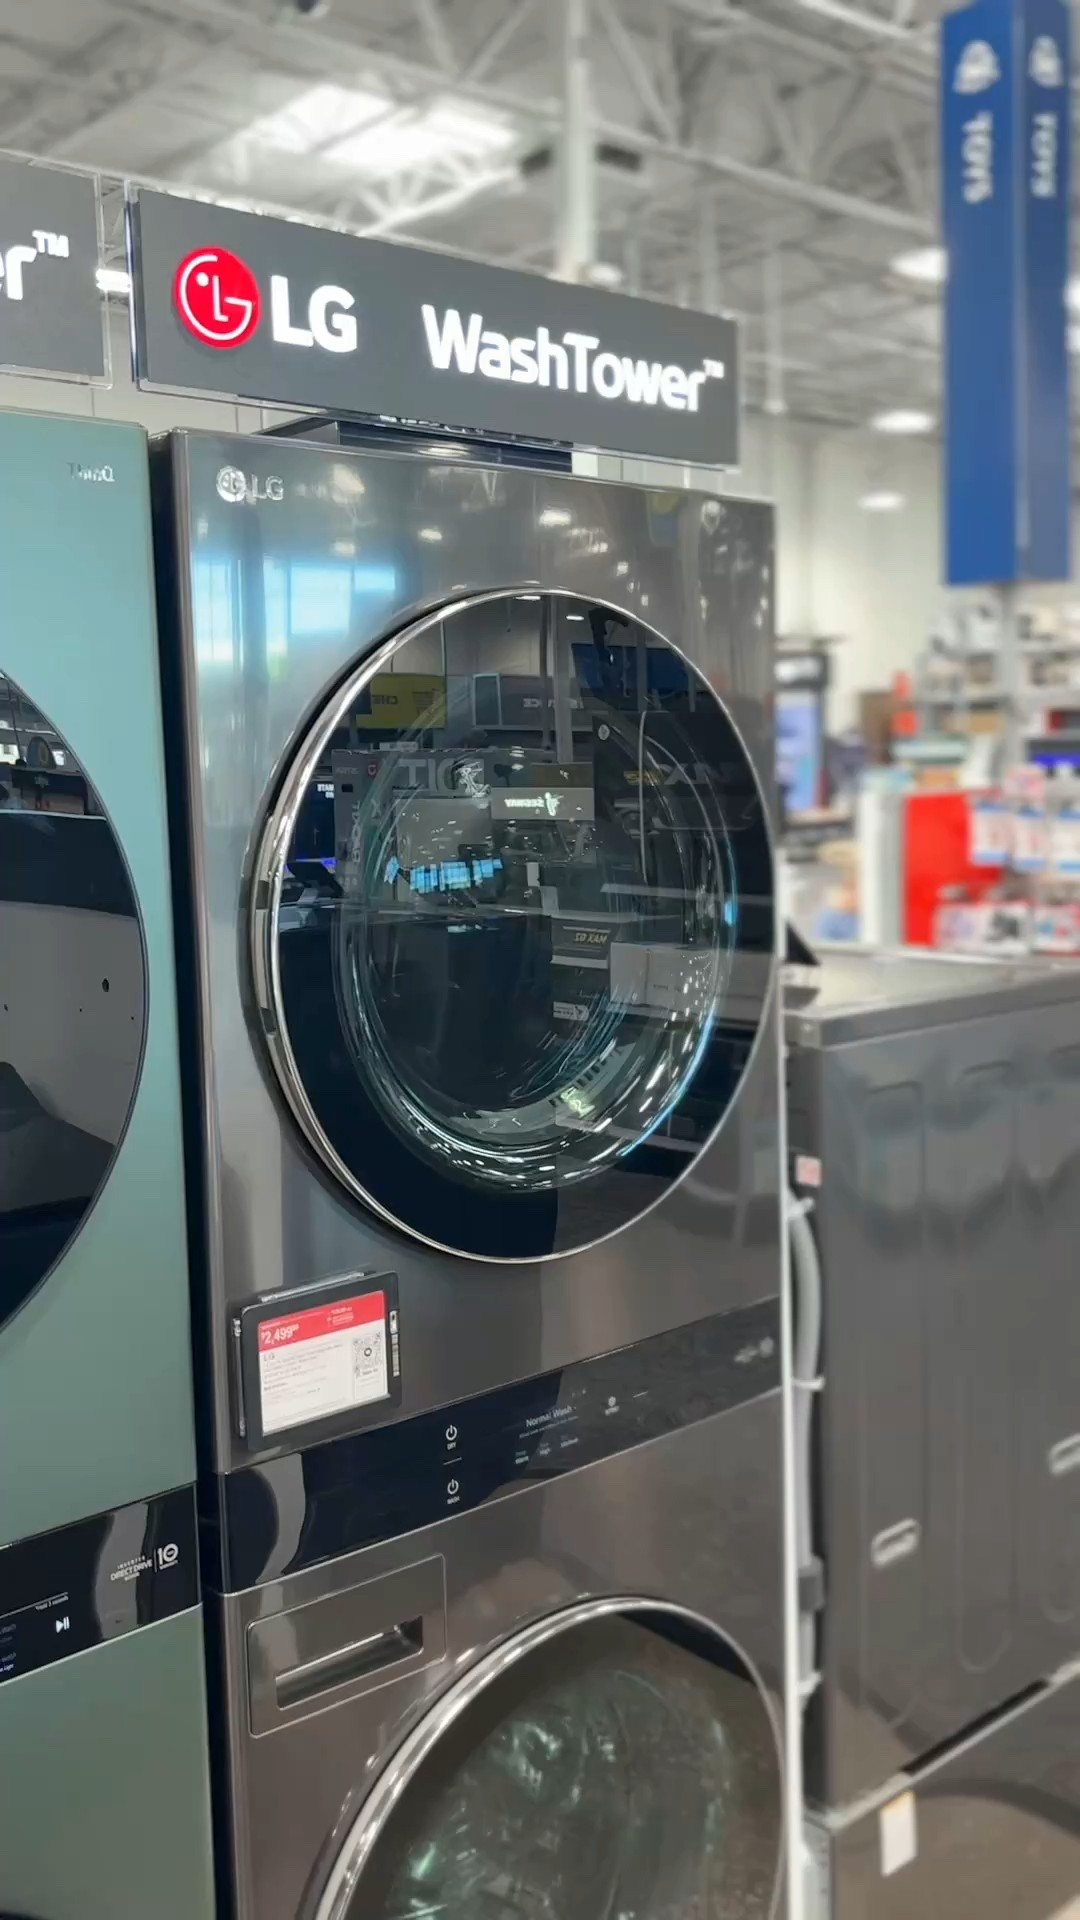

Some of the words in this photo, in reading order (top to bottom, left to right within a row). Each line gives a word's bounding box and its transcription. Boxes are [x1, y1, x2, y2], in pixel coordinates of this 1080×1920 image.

[270, 274, 357, 353] LG
[252, 474, 284, 501] LG
[526, 1411, 552, 1428] Normal
